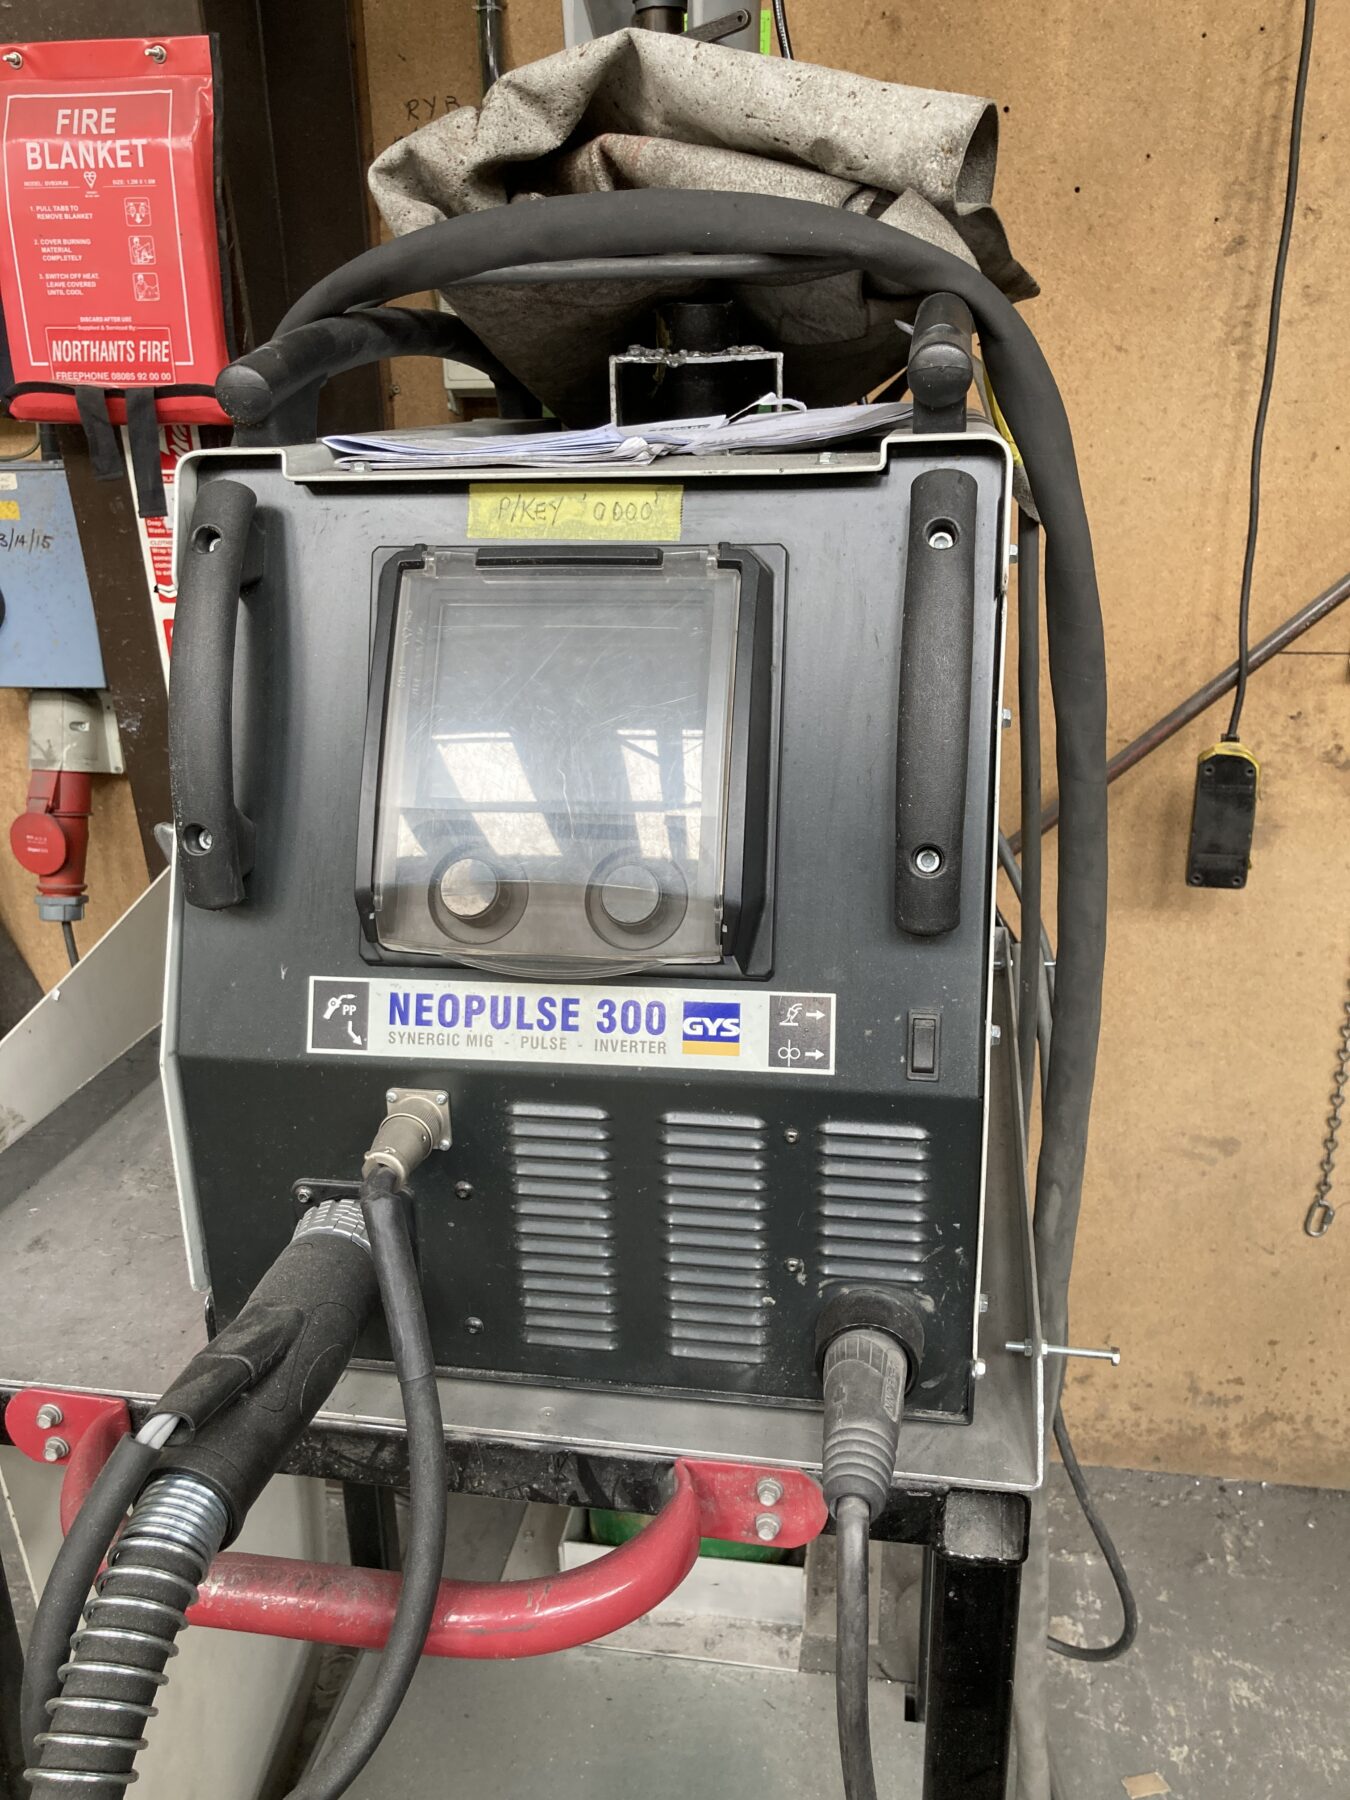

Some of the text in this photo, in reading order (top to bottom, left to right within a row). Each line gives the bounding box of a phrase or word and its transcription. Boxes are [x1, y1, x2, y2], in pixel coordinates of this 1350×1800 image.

[56, 107, 117, 135] FIRE
[25, 138, 148, 170] BLANKET
[52, 340, 170, 363] NORTHANTS FIRE
[55, 371, 109, 381] FREEPHONE
[136, 372, 148, 381] 92
[149, 372, 159, 381] 00
[161, 372, 172, 381] 00
[498, 494, 565, 526] P/KEY
[342, 1004, 357, 1016] PP
[389, 991, 667, 1036] NEOPULSE 300
[682, 1016, 741, 1037] GYS
[388, 1031, 460, 1047] SYNERGIC
[466, 1034, 494, 1048] MIG
[520, 1036, 567, 1051] PULSE
[594, 1038, 667, 1055] INVERTER
